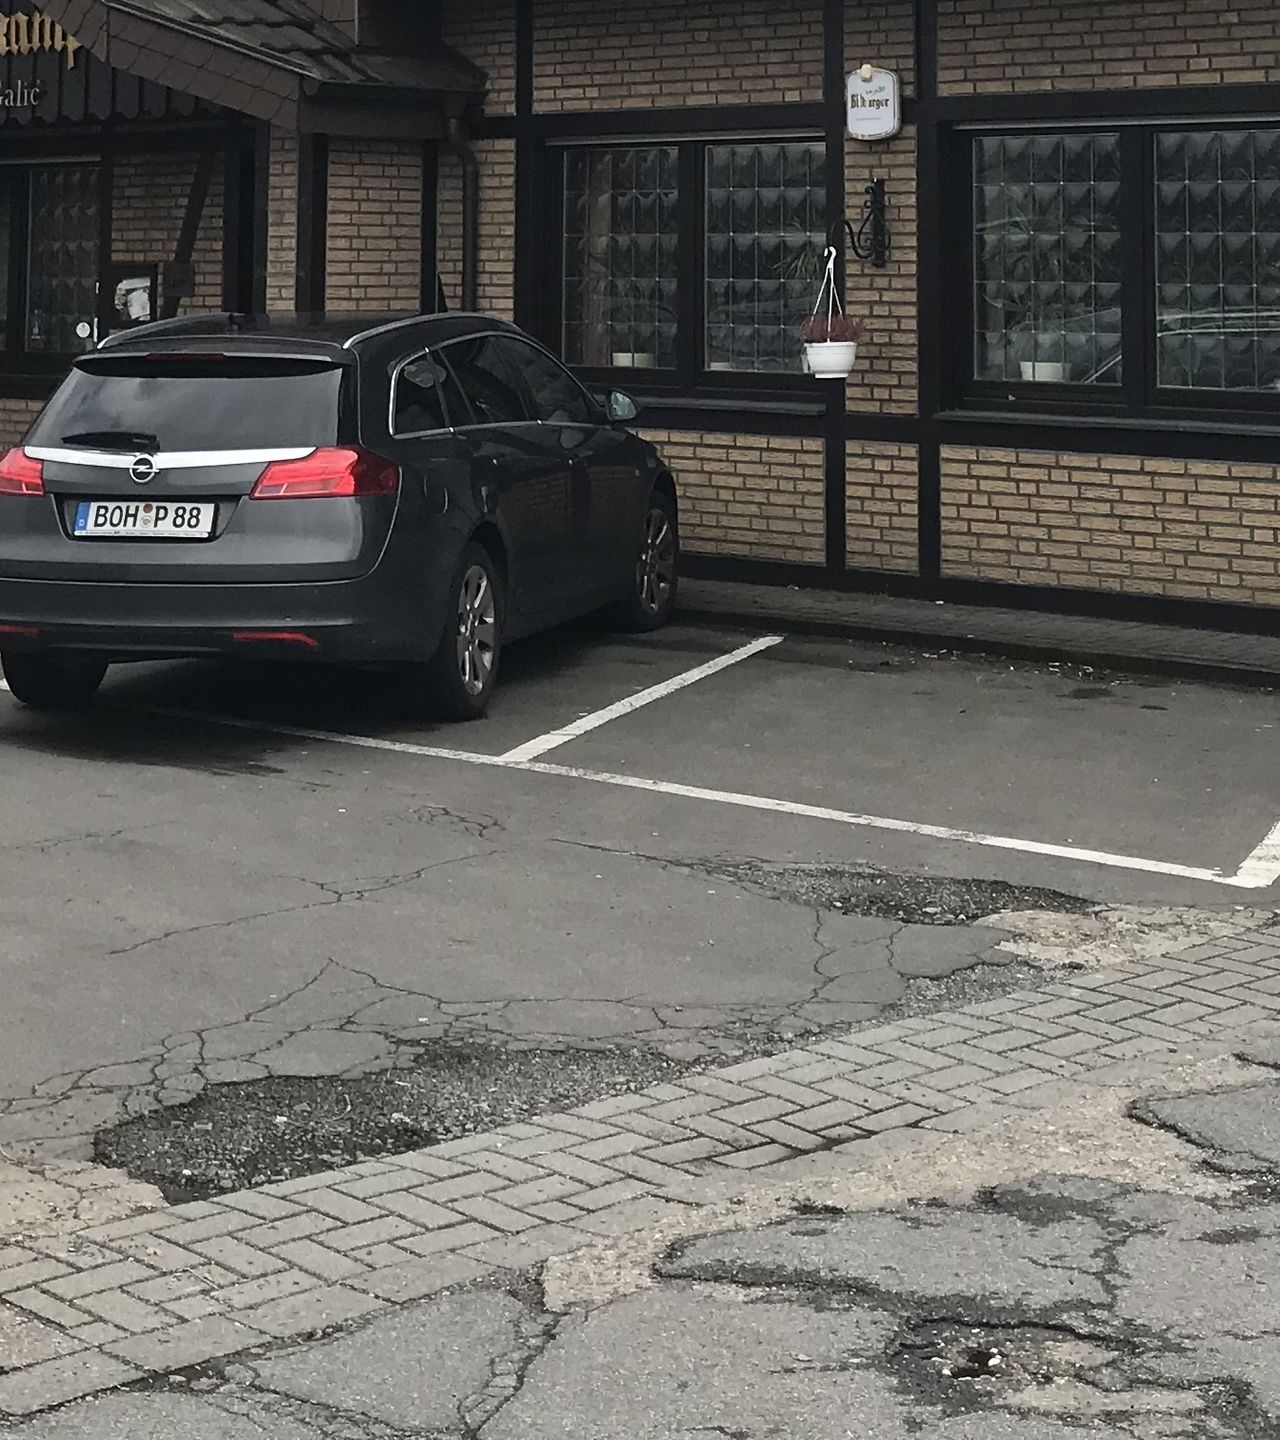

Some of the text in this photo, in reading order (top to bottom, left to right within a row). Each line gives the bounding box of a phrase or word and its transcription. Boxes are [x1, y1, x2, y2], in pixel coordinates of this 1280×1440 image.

[93, 504, 140, 528] BOH
[153, 505, 169, 528] P
[172, 506, 202, 529] 88
